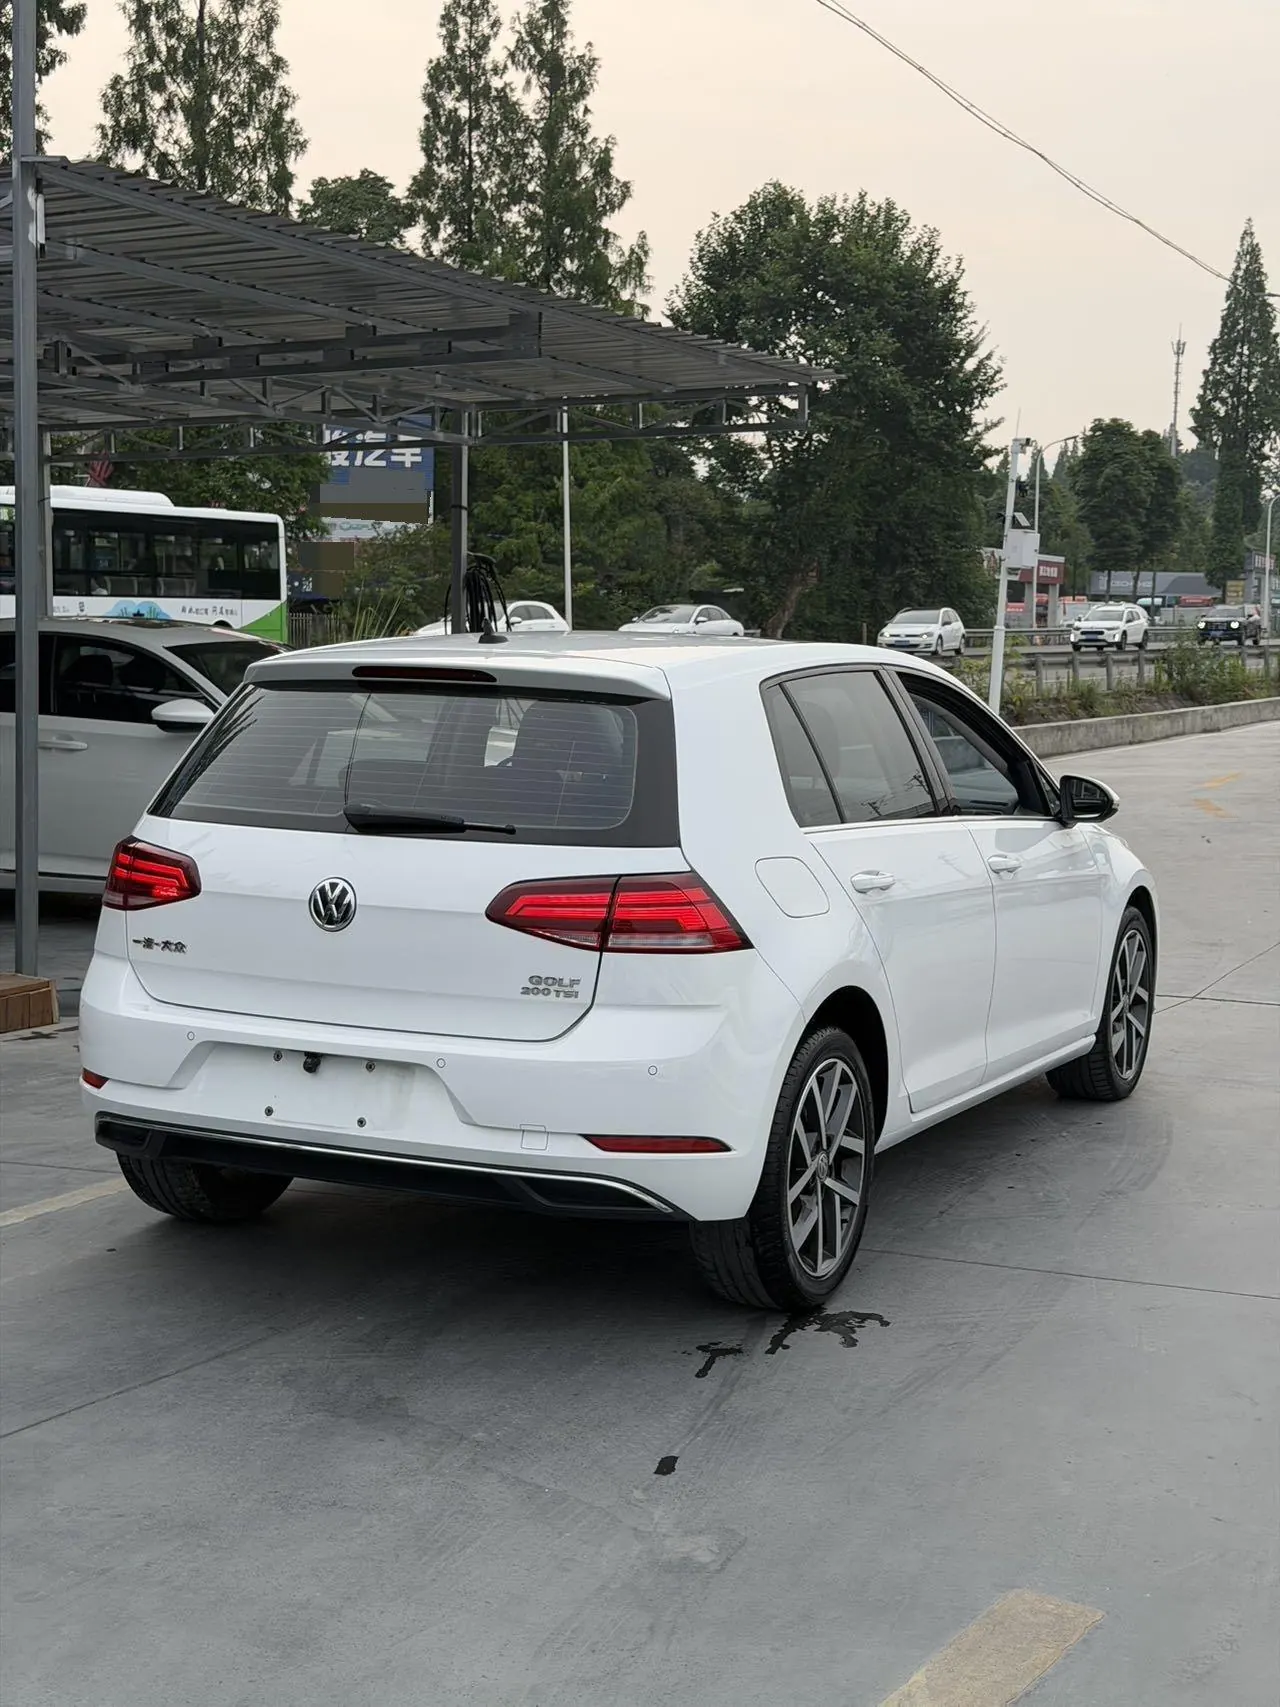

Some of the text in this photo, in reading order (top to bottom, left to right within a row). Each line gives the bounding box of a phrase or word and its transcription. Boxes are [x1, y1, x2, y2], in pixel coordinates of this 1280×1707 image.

[528, 975, 581, 988] GOLF
[520, 987, 579, 998] 200 TSI
